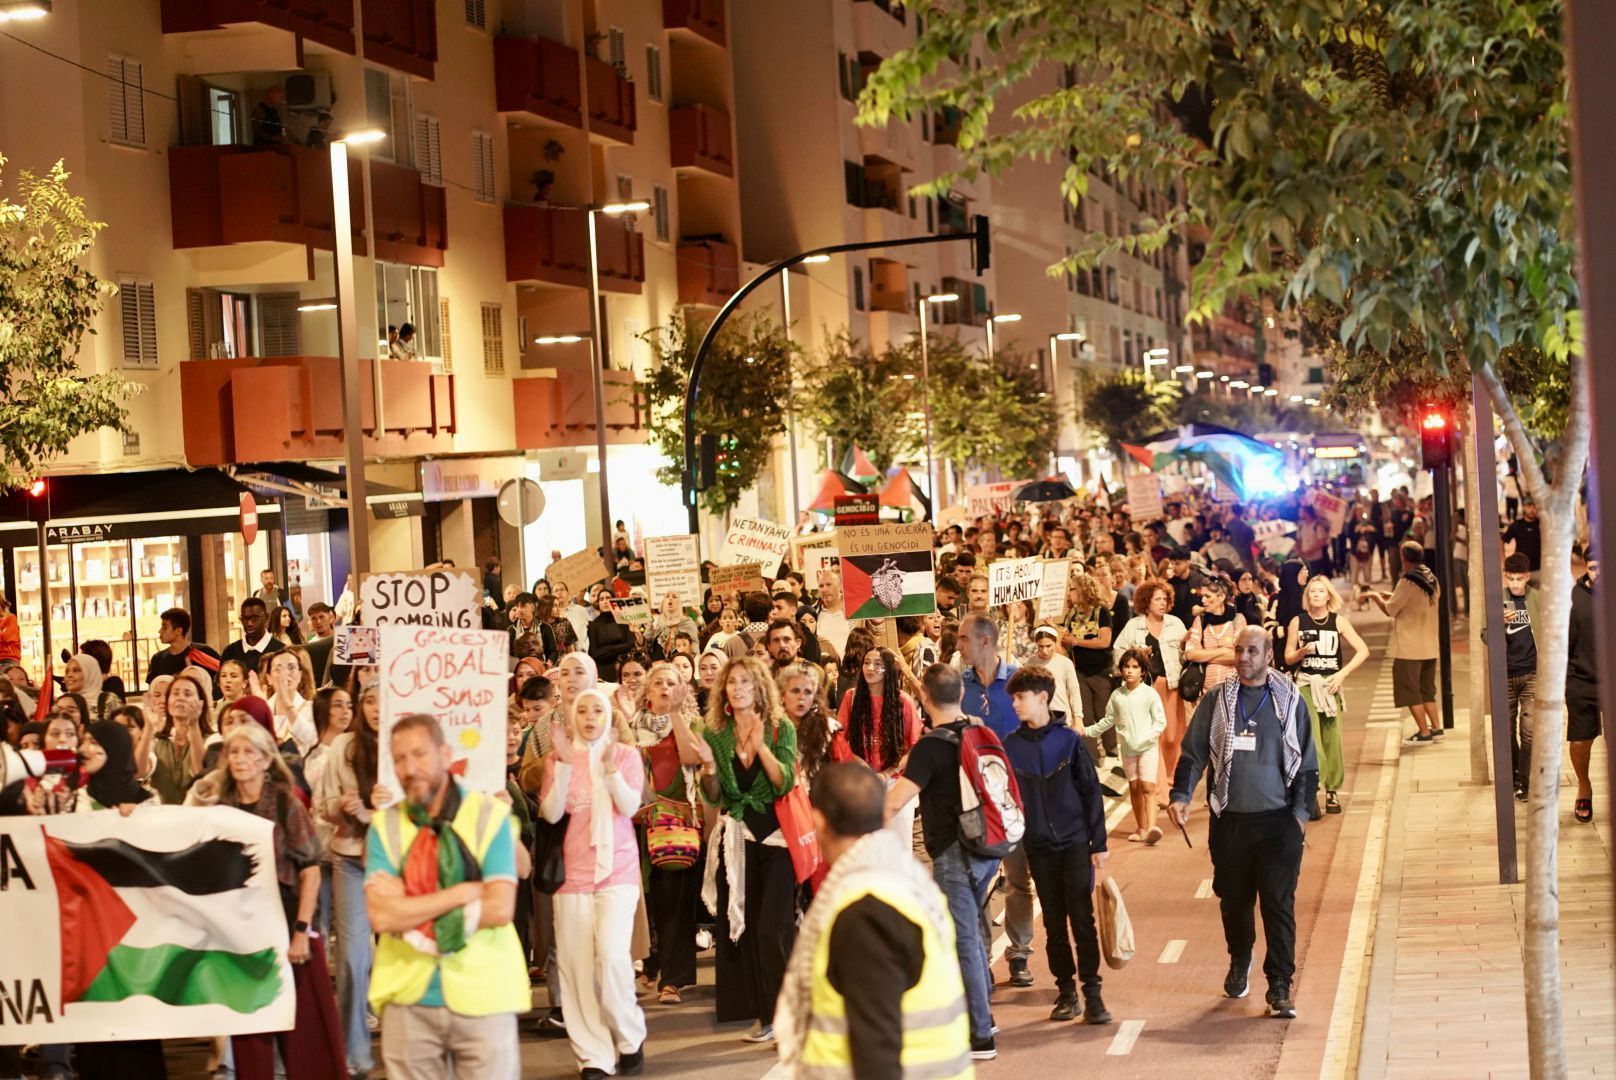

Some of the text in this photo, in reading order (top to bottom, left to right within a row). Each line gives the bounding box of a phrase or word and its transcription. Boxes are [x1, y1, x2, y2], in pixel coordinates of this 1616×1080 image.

[48, 524, 113, 538] ARABAY
[732, 518, 791, 540] NETANYAHU
[844, 529, 857, 538] NO
[728, 533, 785, 556] CRIMINALS
[862, 543, 874, 552] UN
[371, 572, 450, 609] STOP
[994, 579, 1040, 604] HUMANITY
[336, 634, 347, 661] NAZI
[389, 648, 501, 697] GLOBAL
[1301, 657, 1339, 669] ENOCIDE
